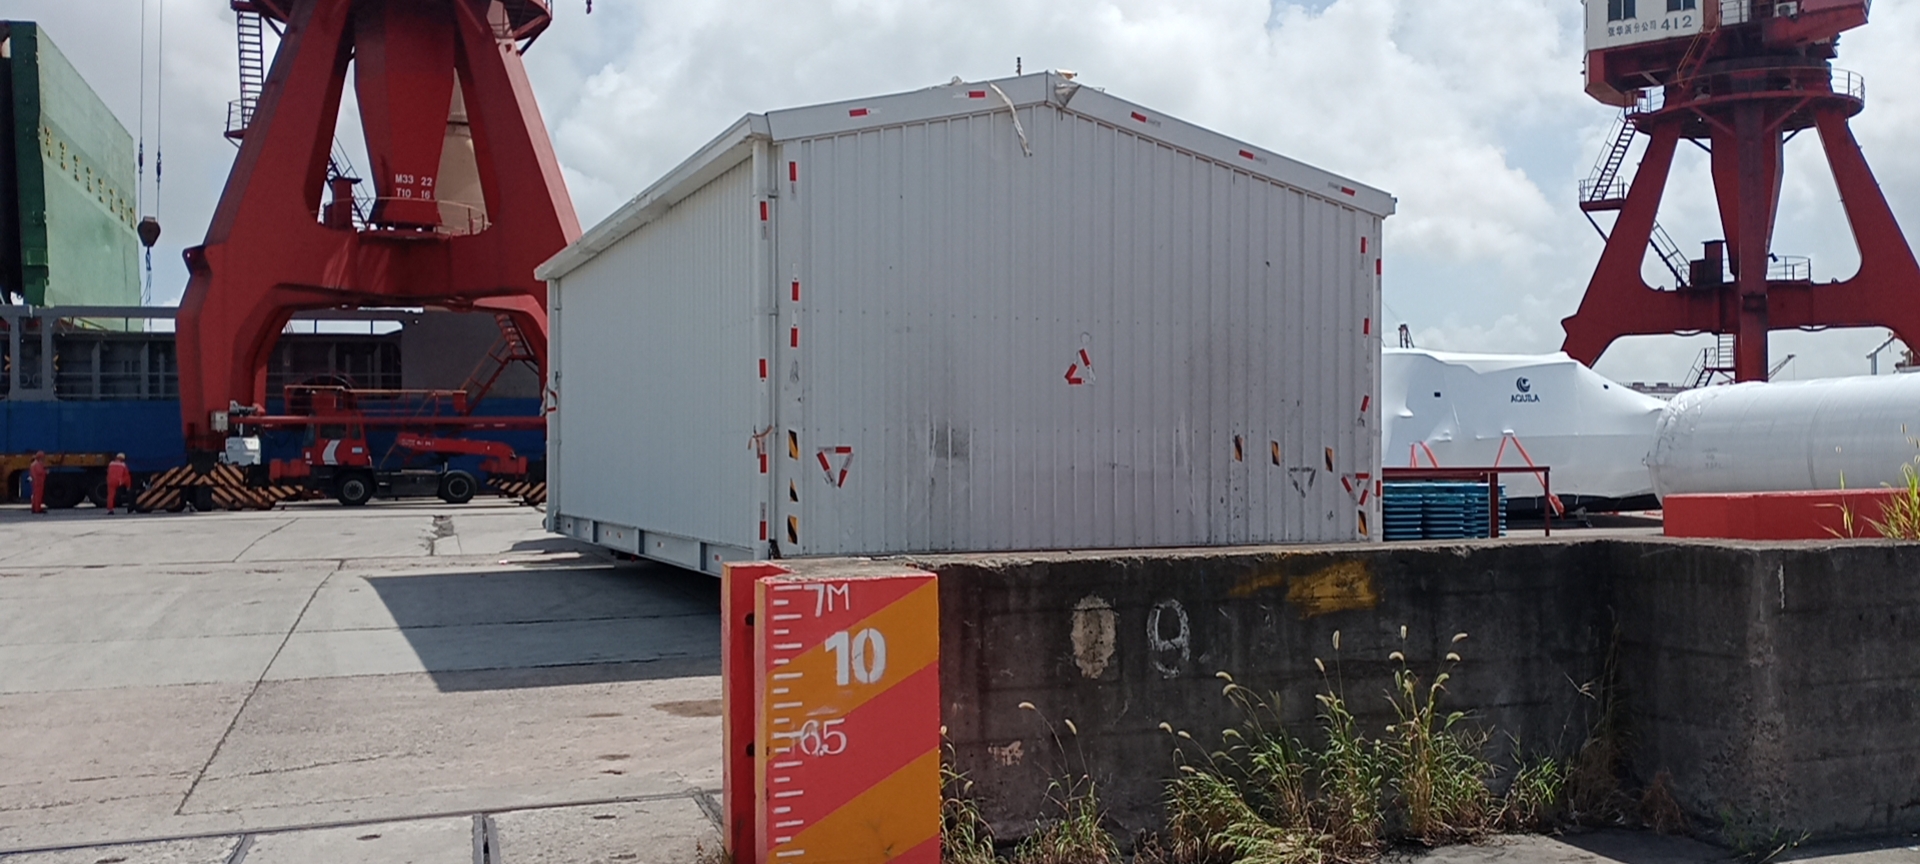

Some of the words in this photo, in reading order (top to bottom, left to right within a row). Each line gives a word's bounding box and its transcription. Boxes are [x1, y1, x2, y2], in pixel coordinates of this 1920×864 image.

[1661, 14, 1692, 31] 412
[395, 174, 414, 184] M33
[421, 176, 433, 187] 22
[396, 187, 412, 198] T10
[421, 190, 431, 200] 16
[1510, 393, 1541, 403] AQUILA
[803, 582, 850, 618] 7M
[824, 627, 887, 687] 10
